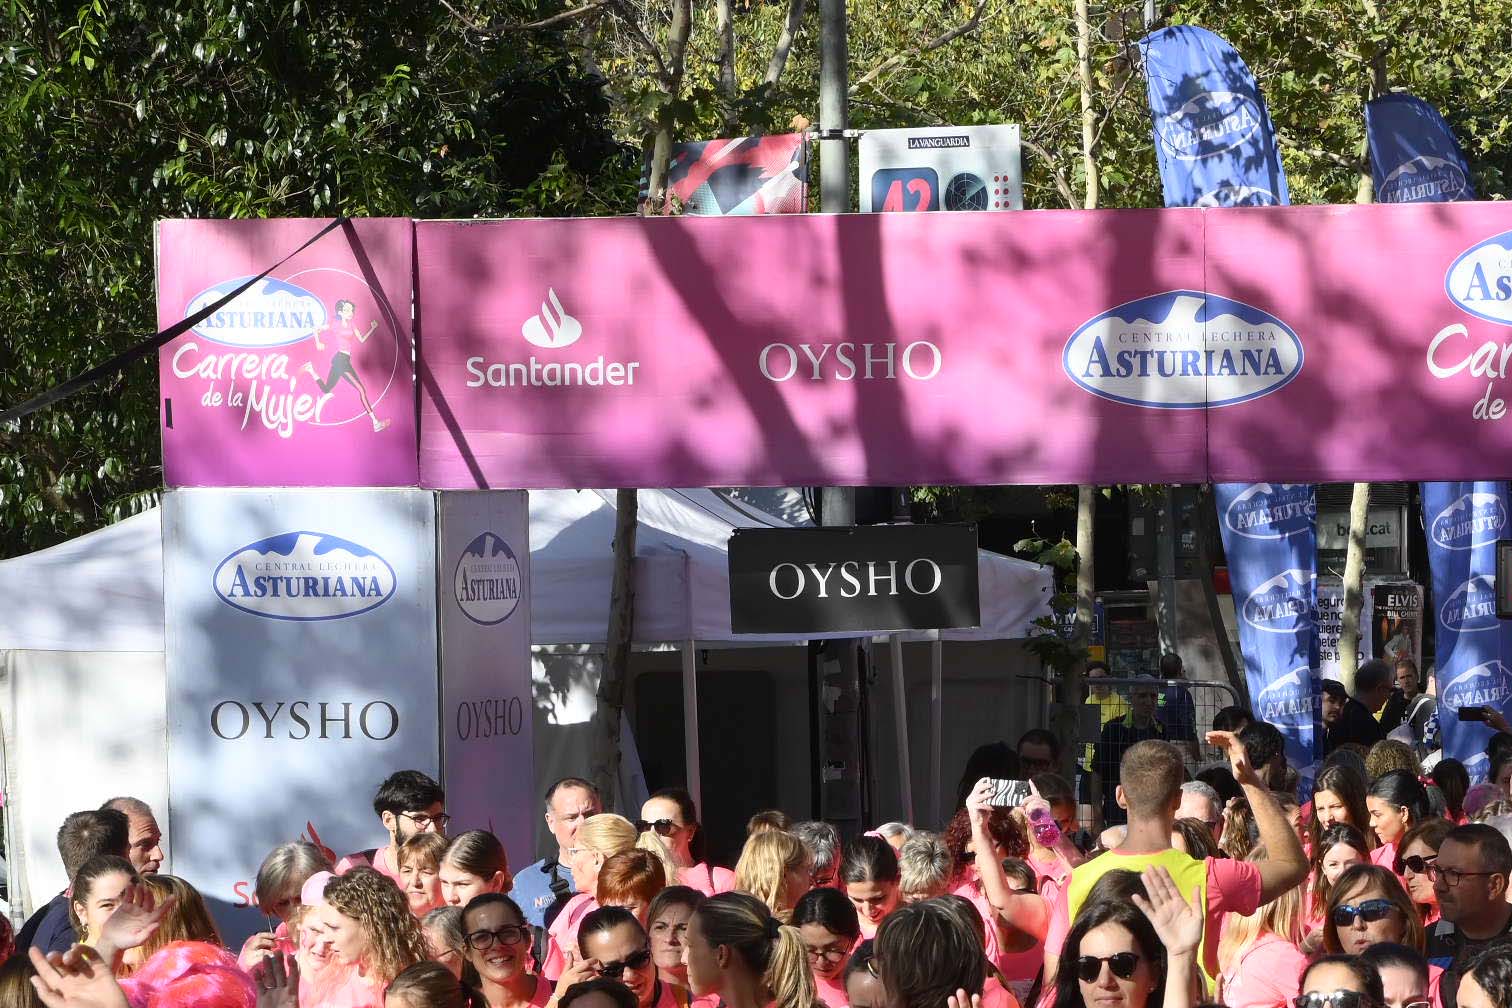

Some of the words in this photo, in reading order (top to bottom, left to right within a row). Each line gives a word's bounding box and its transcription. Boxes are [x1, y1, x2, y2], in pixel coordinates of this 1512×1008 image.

[919, 135, 969, 148] VANGUARDIA
[1117, 331, 1190, 345] CENTRAL
[1200, 329, 1277, 343] LECHERA
[172, 342, 290, 381] Carrera
[465, 356, 641, 389] Santander
[758, 340, 942, 382] OYSHO
[1082, 335, 1286, 379] ASTURIANA
[201, 382, 224, 408] de
[227, 382, 244, 408] la
[240, 374, 335, 438] Mujer
[1472, 383, 1507, 421] de
[1337, 522, 1391, 537] b.cat
[227, 564, 384, 598] ASTURIANA
[255, 562, 314, 571] CENTRAL
[459, 566, 518, 602] ASTURIANA
[768, 557, 943, 600] OYSHO
[1387, 594, 1418, 607] ELVIS
[210, 700, 399, 741] OYSHO
[456, 695, 523, 741] OYSHO
